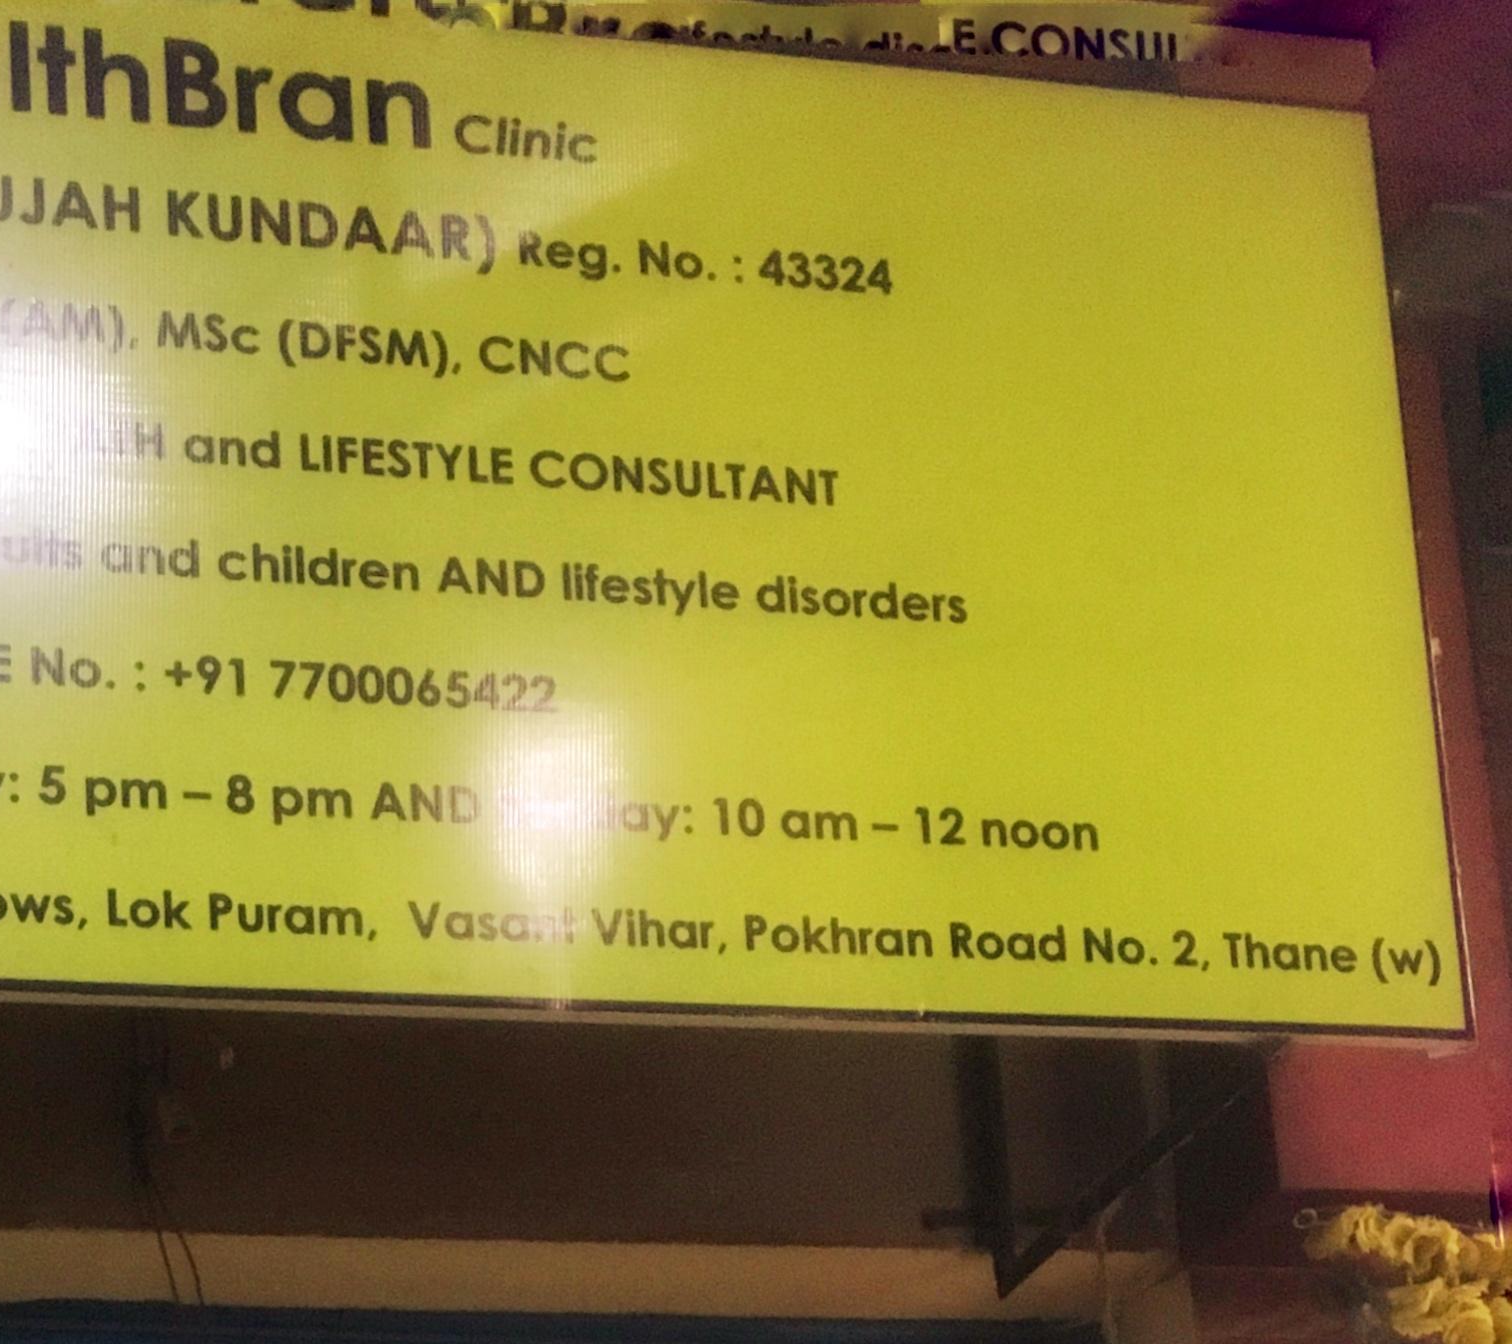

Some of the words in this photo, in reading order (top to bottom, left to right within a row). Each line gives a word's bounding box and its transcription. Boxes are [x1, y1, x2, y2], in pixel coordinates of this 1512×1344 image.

[454, 114, 598, 164] Clinic
[166, 189, 497, 274] KUNDAAR)
[518, 229, 621, 281] Reg.
[638, 239, 717, 282] No.
[758, 248, 893, 295] 43324
[156, 310, 260, 355] MSc
[278, 318, 462, 378] (DFSM),
[478, 335, 632, 382] CNCC
[184, 431, 281, 470] and
[300, 433, 514, 486] LIFESTYLE
[528, 448, 839, 506] CONSULTANT
[101, 539, 200, 579] and
[217, 542, 420, 593] children
[437, 556, 546, 600] AND
[561, 562, 740, 617] lifestyle
[755, 575, 969, 625] disorders
[29, 645, 117, 690] No.
[164, 654, 247, 698] +91
[269, 658, 558, 713] 7700065422
[37, 764, 67, 806] 5
[85, 774, 169, 816] pm
[225, 773, 256, 815] 8
[272, 782, 354, 826] pm
[369, 782, 482, 827] AND
[712, 797, 766, 839] 10
[779, 809, 859, 842] am
[913, 805, 966, 848] 12
[980, 816, 1101, 853] noon
[107, 887, 193, 931] Lok
[207, 892, 378, 943] Puram,
[591, 906, 728, 956] Vihar,
[743, 913, 933, 960] Pokhran
[949, 920, 1068, 964] Road
[1083, 926, 1159, 968] No.
[1172, 929, 1211, 973] 2,
[1223, 930, 1358, 975] Thane
[1371, 936, 1443, 987] (w)
